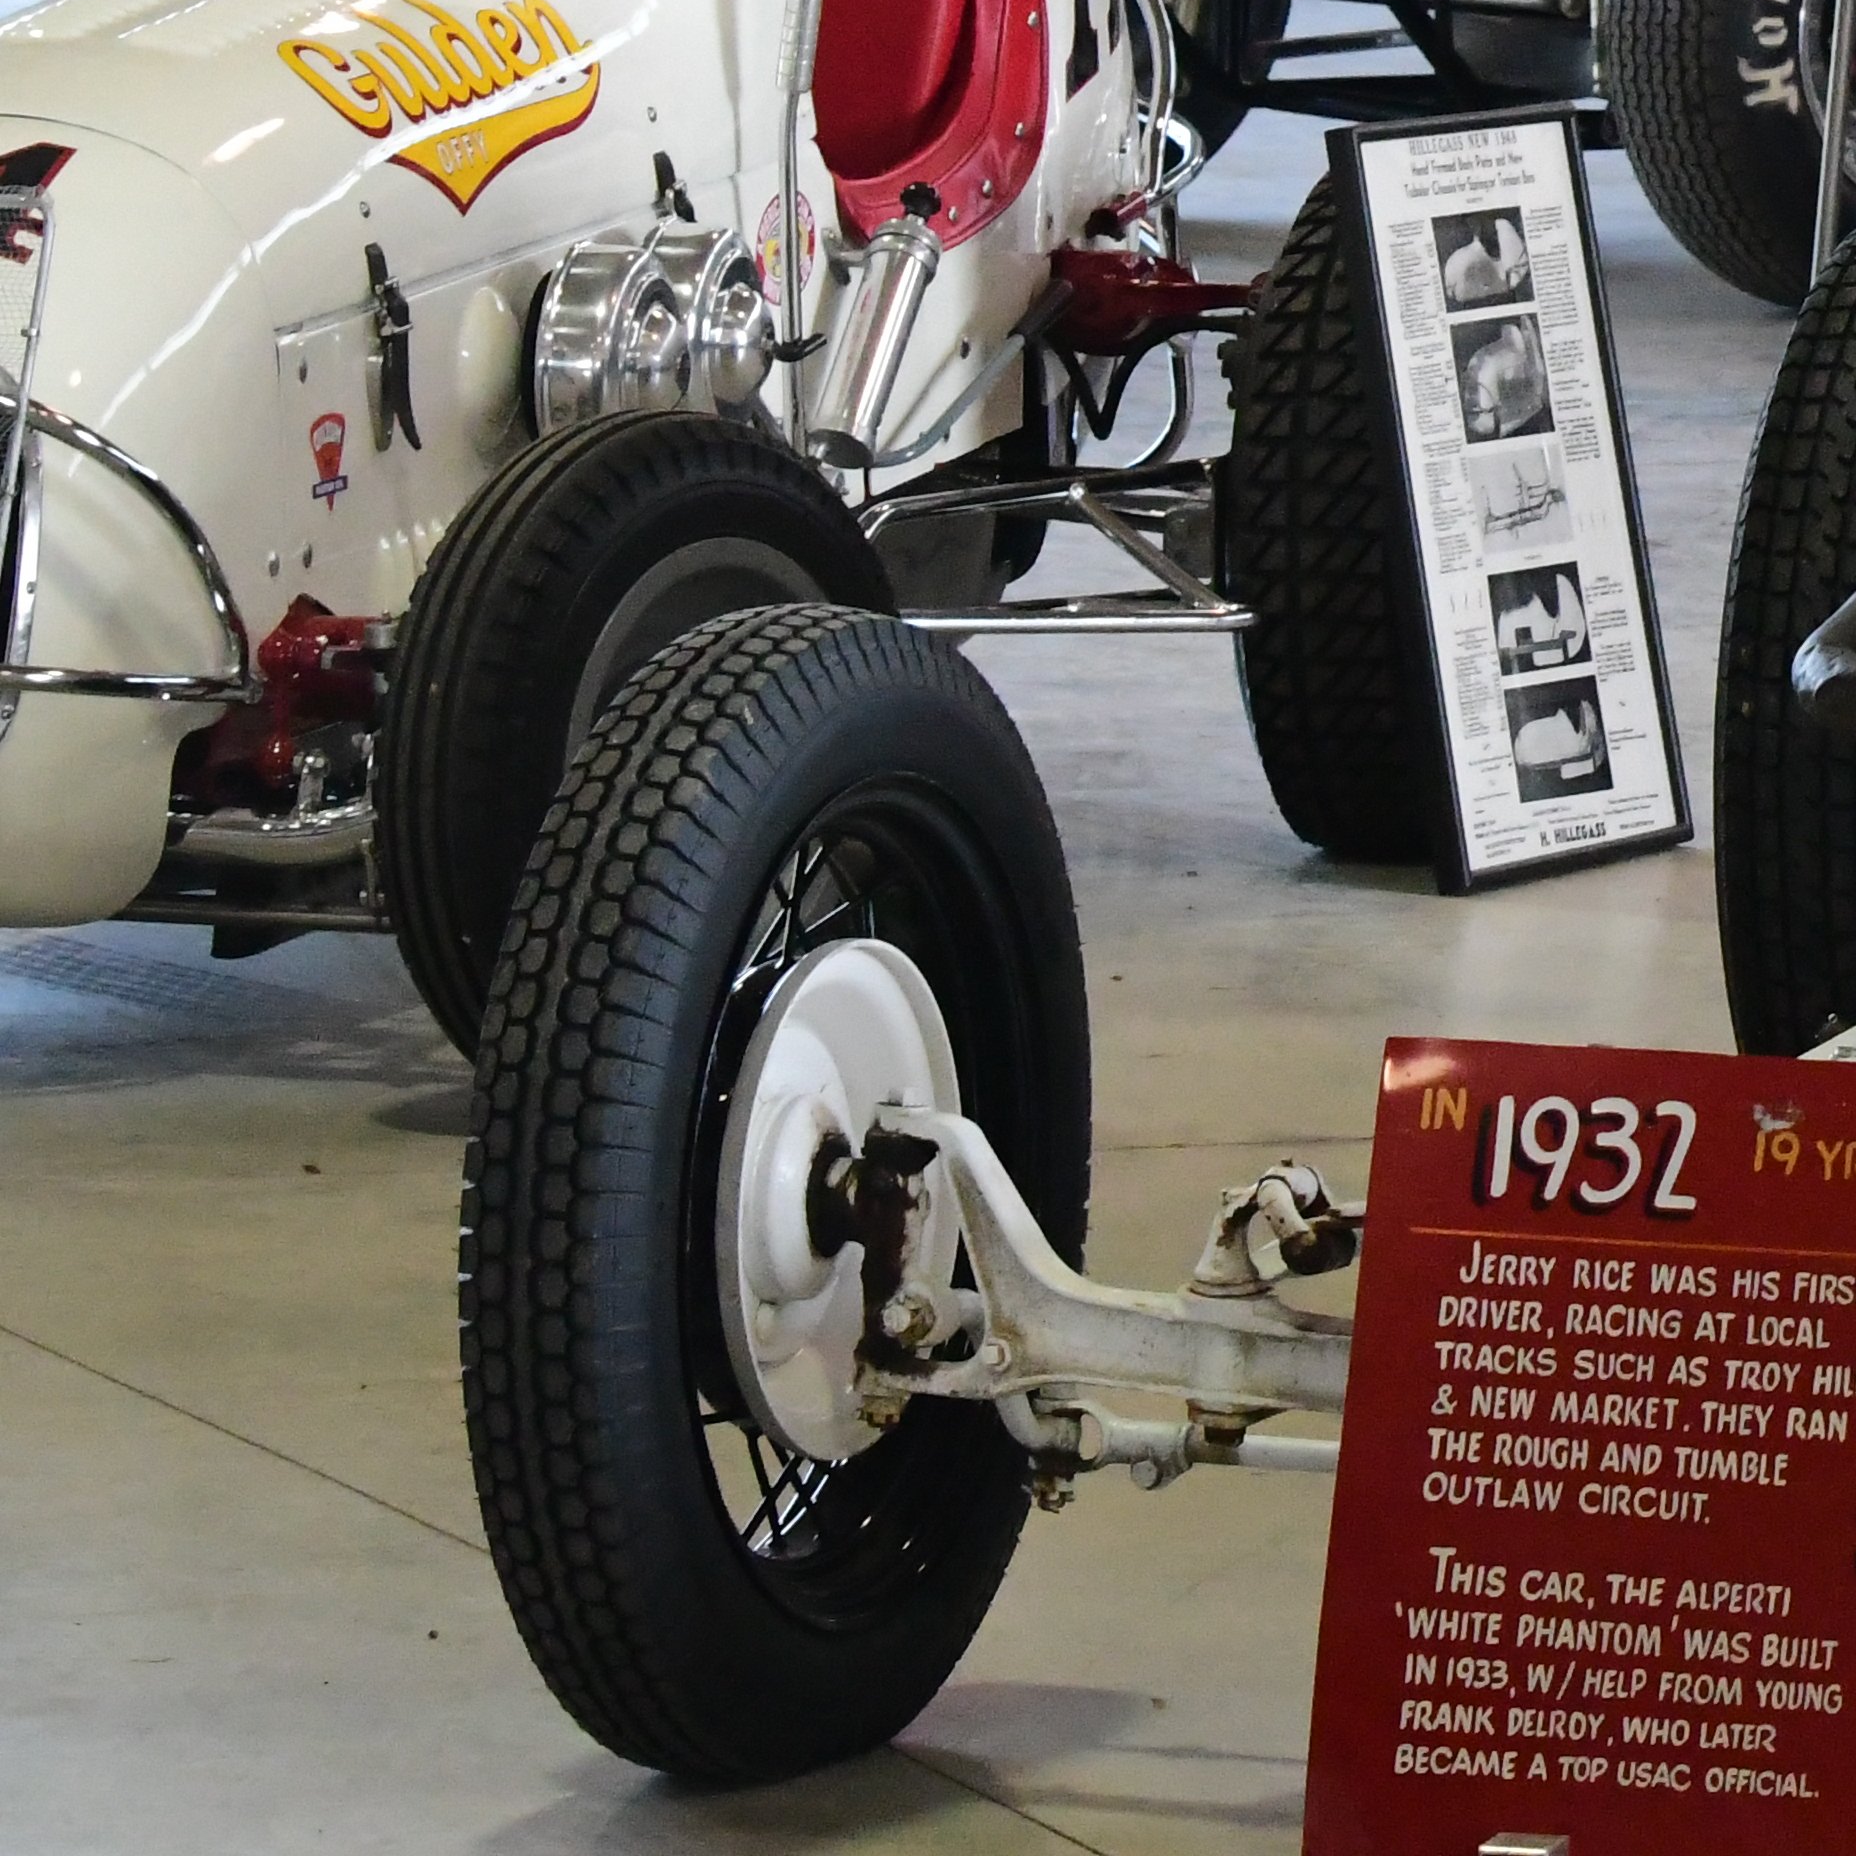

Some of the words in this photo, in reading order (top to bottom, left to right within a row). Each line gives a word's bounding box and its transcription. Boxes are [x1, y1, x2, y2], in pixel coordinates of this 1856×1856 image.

[435, 129, 492, 175] OFFY
[1553, 821, 1607, 843] HILLEGASS
[1421, 1088, 1466, 1129] IN
[1490, 1095, 1696, 1209] 1932
[1753, 1133, 1798, 1174] 19
[1460, 1241, 1556, 1285] JERRY
[1574, 1259, 1635, 1292] RICE
[1651, 1264, 1716, 1296] WAS
[1733, 1270, 1780, 1300] HIS
[1439, 1296, 1553, 1339] DRIVER,
[1566, 1304, 1682, 1338] RACING
[1694, 1312, 1736, 1343] AT
[1747, 1315, 1830, 1348] LOCAL
[1435, 1341, 1557, 1376] TRACKS
[1574, 1350, 1654, 1381] SUCH
[1668, 1356, 1708, 1386] AS
[1725, 1360, 1801, 1392] TROY
[1432, 1384, 1457, 1414] &
[1471, 1386, 1535, 1420] NEW
[1551, 1392, 1689, 1431] MARKET.
[1701, 1402, 1773, 1437] THEY
[1787, 1408, 1847, 1442] RAN
[1428, 1428, 1483, 1462] THE
[1494, 1433, 1588, 1470] ROUGH
[1600, 1442, 1662, 1475] AND
[1675, 1447, 1788, 1486] TUMBLE
[1423, 1472, 1563, 1511] OUTLAW
[1579, 1483, 1709, 1523] CIRCUIT.
